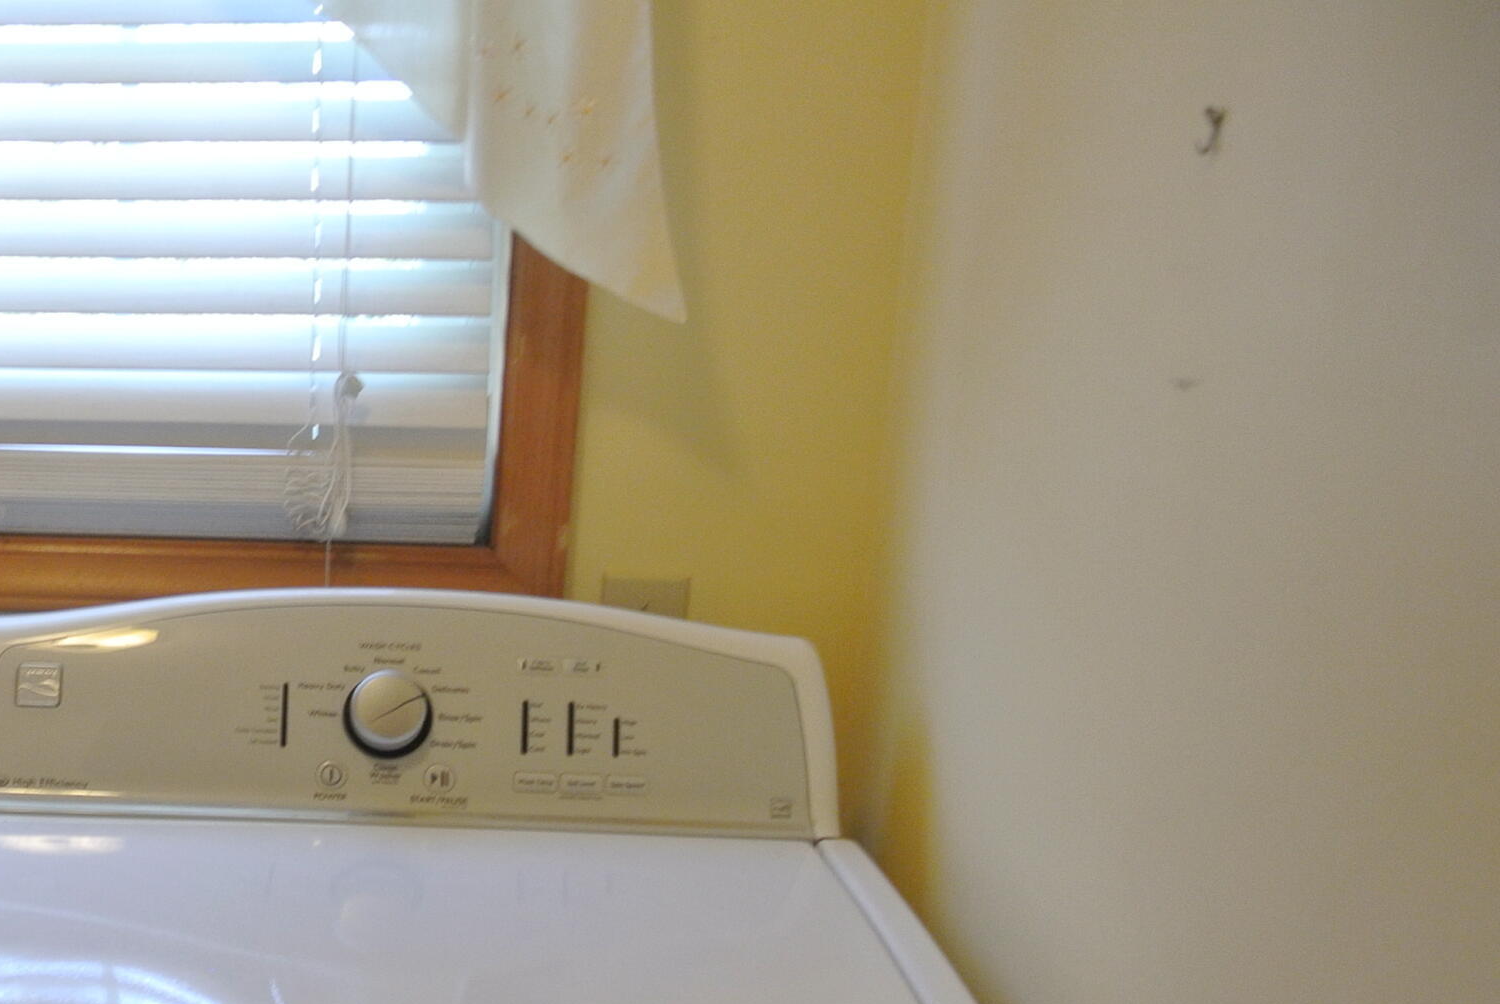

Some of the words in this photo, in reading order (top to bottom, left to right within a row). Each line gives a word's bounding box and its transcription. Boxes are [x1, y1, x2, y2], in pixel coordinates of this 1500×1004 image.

[373, 655, 406, 664] Normal
[297, 681, 325, 691] Heavy
[326, 682, 346, 691] Duty
[313, 792, 347, 801] POWER
